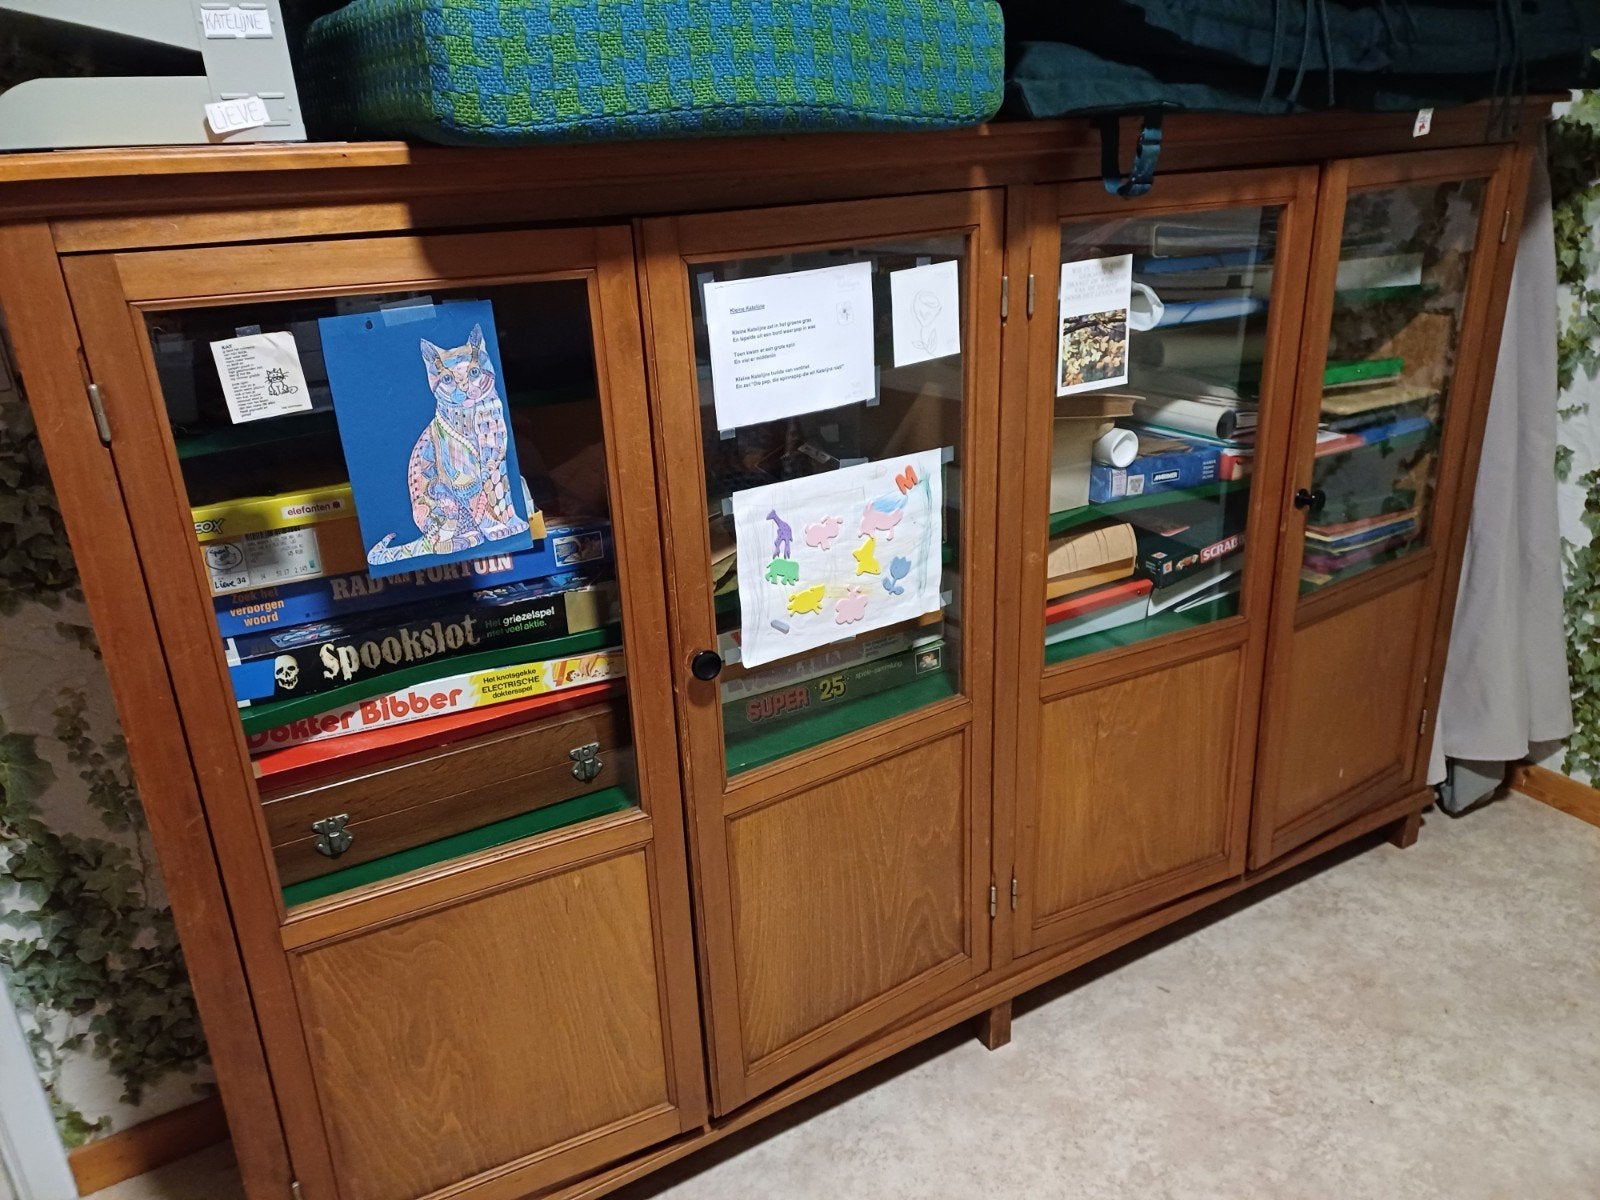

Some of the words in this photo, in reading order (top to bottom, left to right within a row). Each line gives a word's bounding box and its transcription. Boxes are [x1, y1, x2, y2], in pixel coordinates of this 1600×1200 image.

[287, 504, 331, 516] elefanten
[329, 573, 385, 601] RAD
[244, 611, 279, 627] woord
[503, 606, 555, 627] griezelspel
[505, 623, 522, 634] veel
[524, 620, 547, 630] aktie.
[319, 614, 481, 681] Spookslot
[482, 675, 540, 694] ELECTRISCHE
[483, 675, 496, 684] Het
[496, 668, 537, 681] knotsgekke
[492, 685, 533, 699] doktersspel
[746, 685, 812, 723] SUPER
[819, 673, 847, 701] 25
[360, 687, 462, 726] Bibber
